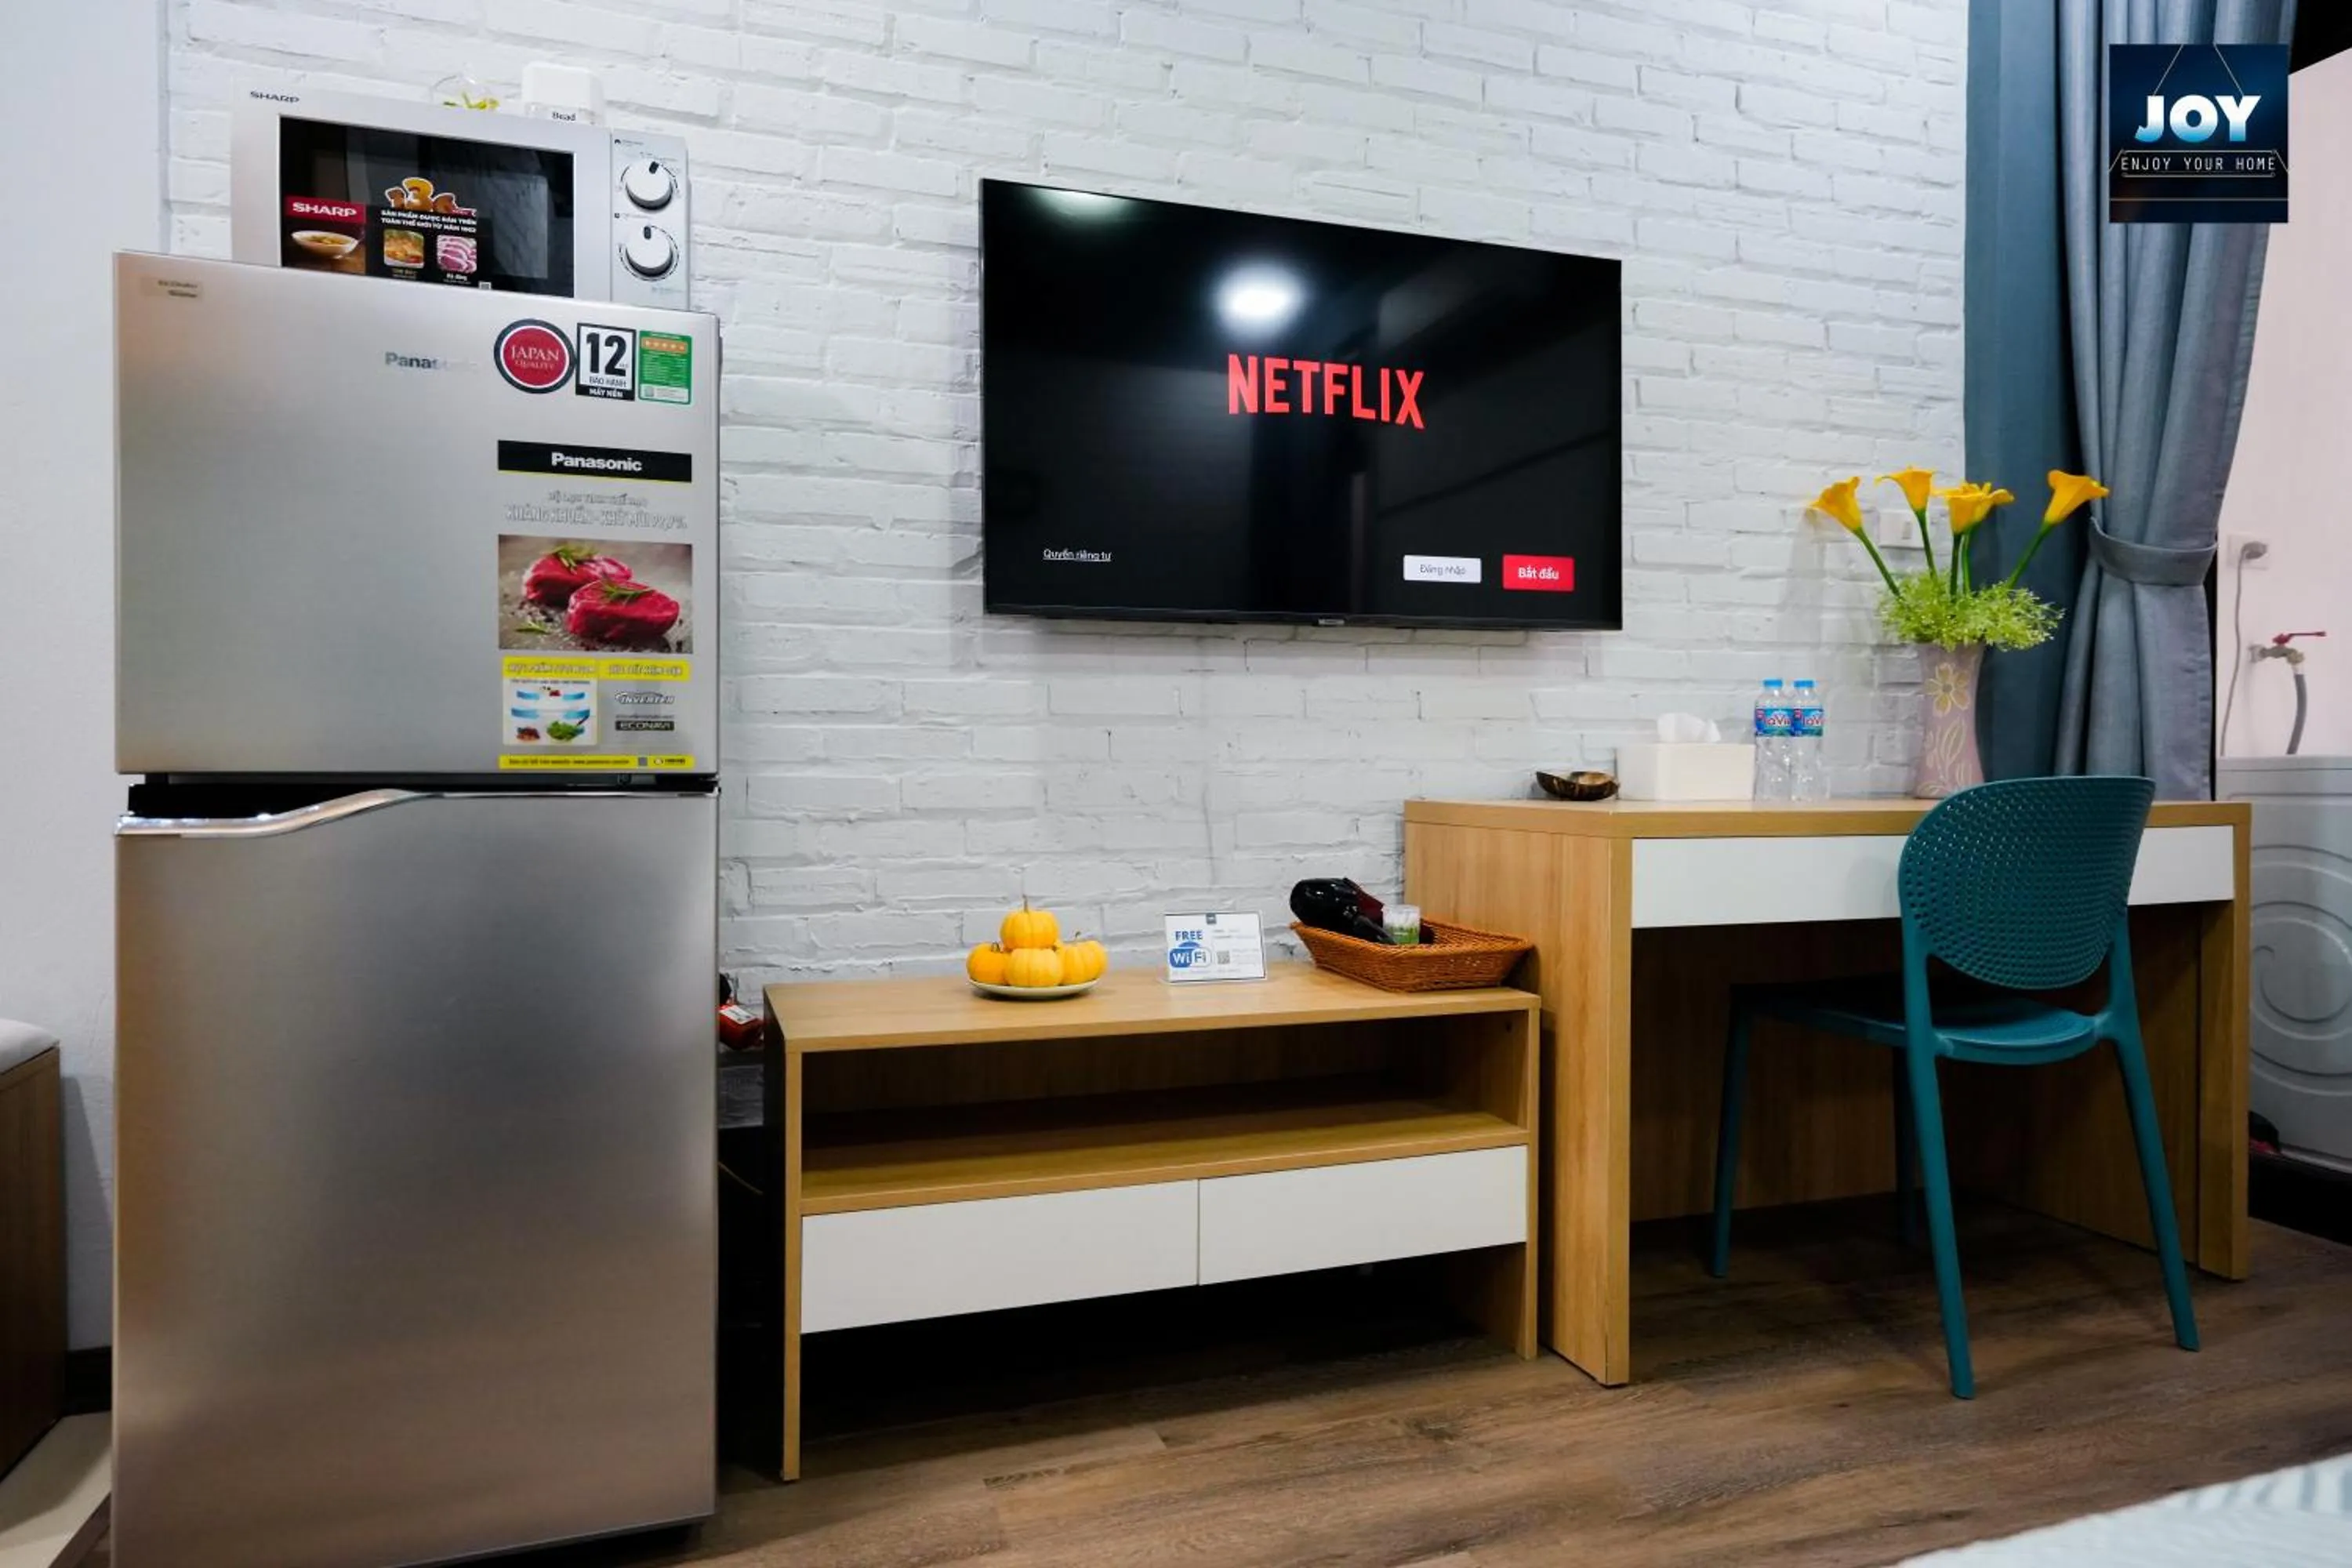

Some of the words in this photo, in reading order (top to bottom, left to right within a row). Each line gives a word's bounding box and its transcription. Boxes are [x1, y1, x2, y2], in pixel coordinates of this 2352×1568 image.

[250, 90, 299, 103] SHARP
[292, 201, 358, 218] SHARP
[511, 344, 560, 361] JAPAN
[586, 332, 626, 377] 12
[514, 359, 555, 372] QUALITY
[1229, 353, 1425, 430] NETFLIX
[551, 452, 643, 472] Panasonic
[1044, 548, 1074, 561] Quyền
[1076, 549, 1099, 562] riêng
[1420, 564, 1443, 576] Đăng
[1444, 565, 1466, 576] nhập
[1518, 564, 1537, 579] Bắt
[1539, 566, 1559, 580] đầu
[621, 695, 674, 704] INVERTER
[619, 721, 671, 731] ECONAVI
[1175, 930, 1203, 941] FREE
